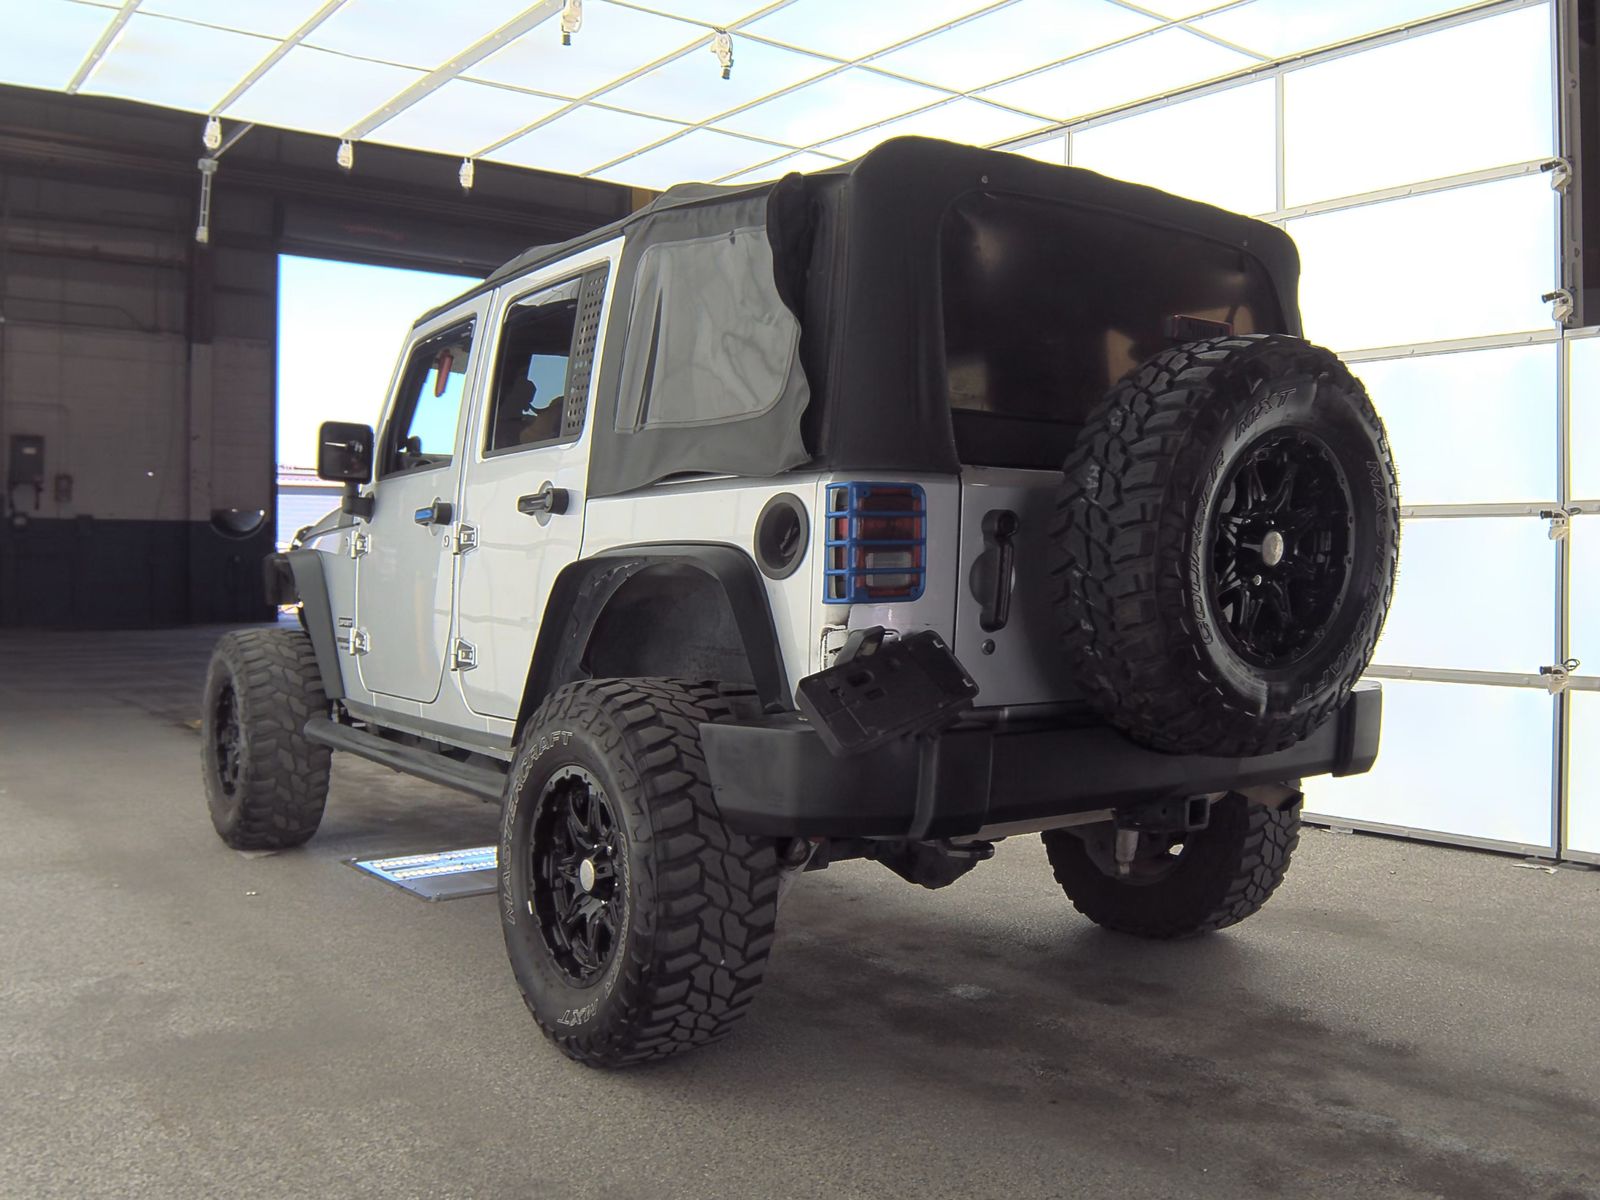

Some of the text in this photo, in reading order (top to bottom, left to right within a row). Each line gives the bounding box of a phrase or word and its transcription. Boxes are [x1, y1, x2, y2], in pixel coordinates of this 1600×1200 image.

[1235, 388, 1297, 442] MXT
[502, 729, 574, 925] MASTERCRAFT
[557, 998, 599, 1026] MXT
